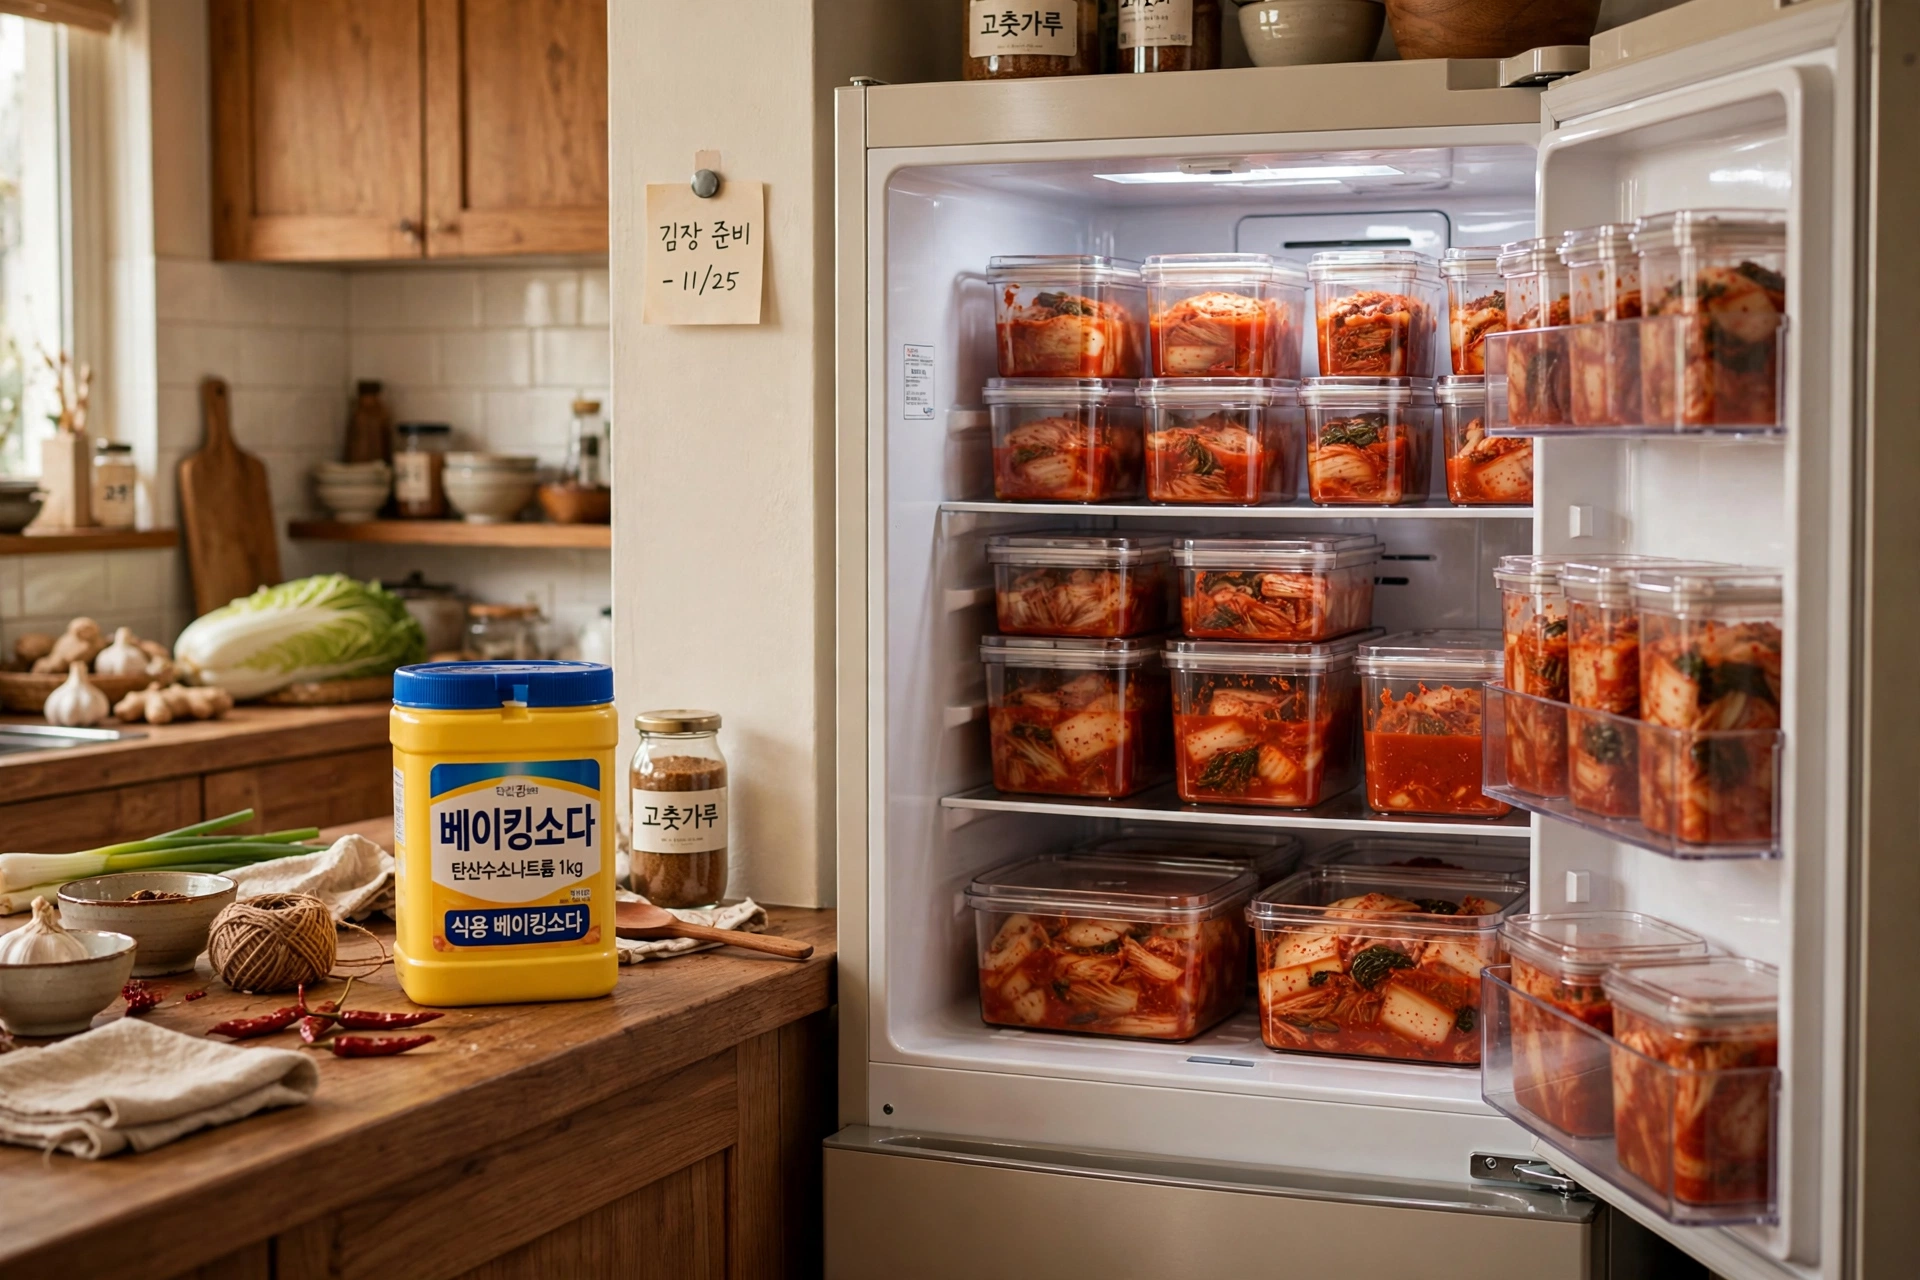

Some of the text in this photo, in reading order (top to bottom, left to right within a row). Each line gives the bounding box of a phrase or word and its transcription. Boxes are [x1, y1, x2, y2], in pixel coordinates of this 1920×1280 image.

[981, 10, 1064, 37] 고춧가루
[660, 220, 750, 252] 김장 준비
[440, 803, 596, 852] 베이킹소다
[642, 803, 719, 831] 고춧가루
[451, 858, 584, 881] 탄산수소나트륨 1kg
[451, 910, 583, 939] 식용 베이킹소다
